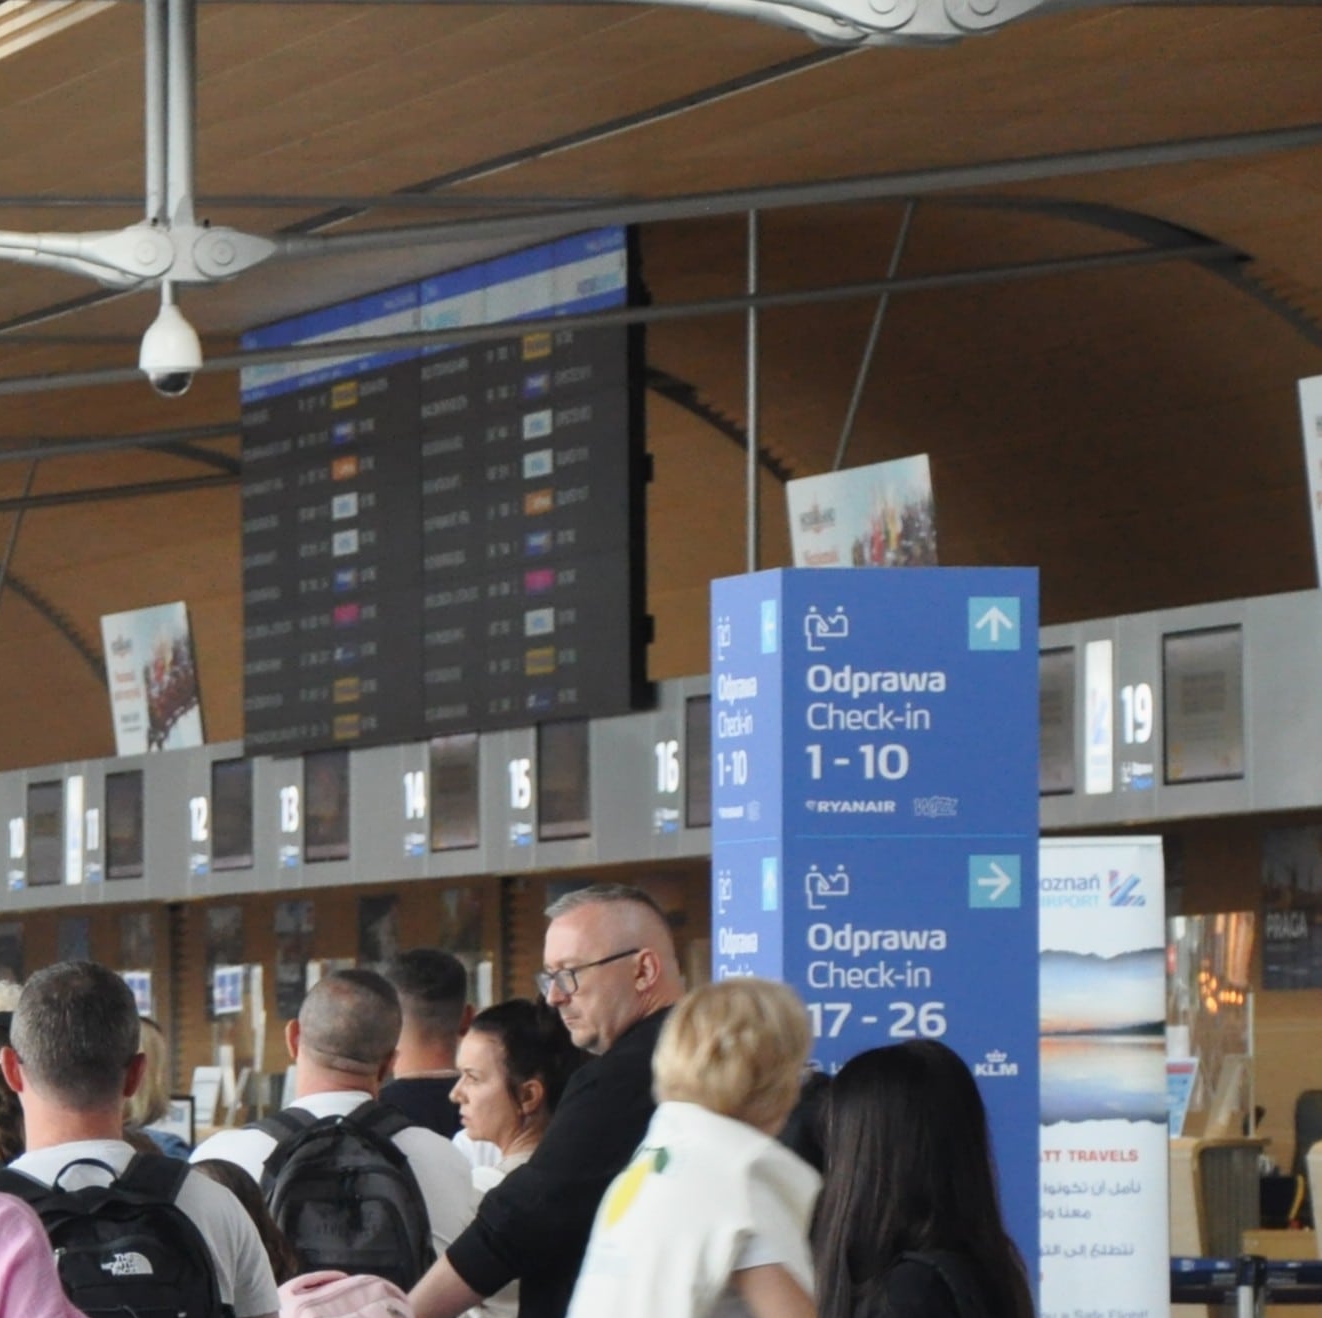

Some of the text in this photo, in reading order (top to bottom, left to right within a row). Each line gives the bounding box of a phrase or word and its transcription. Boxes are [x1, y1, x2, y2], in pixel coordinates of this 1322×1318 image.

[806, 664, 947, 699] Odprawa
[806, 702, 931, 731] Check-in
[1120, 682, 1154, 745] 19
[654, 739, 680, 794] 16
[806, 744, 822, 780] 1
[858, 744, 910, 780] 10
[403, 770, 426, 820] 14
[508, 757, 531, 810] 15
[189, 796, 209, 842] 12
[279, 785, 300, 834] 13
[817, 800, 896, 813] RYANAIR
[1041, 873, 1100, 892] oznań
[807, 923, 948, 957] Odprawa
[807, 960, 932, 989] Check-in
[807, 1002, 853, 1038] 17
[888, 1001, 947, 1038] 26
[974, 1063, 1018, 1076] KLM
[1069, 1150, 1139, 1162] TRAVELS
